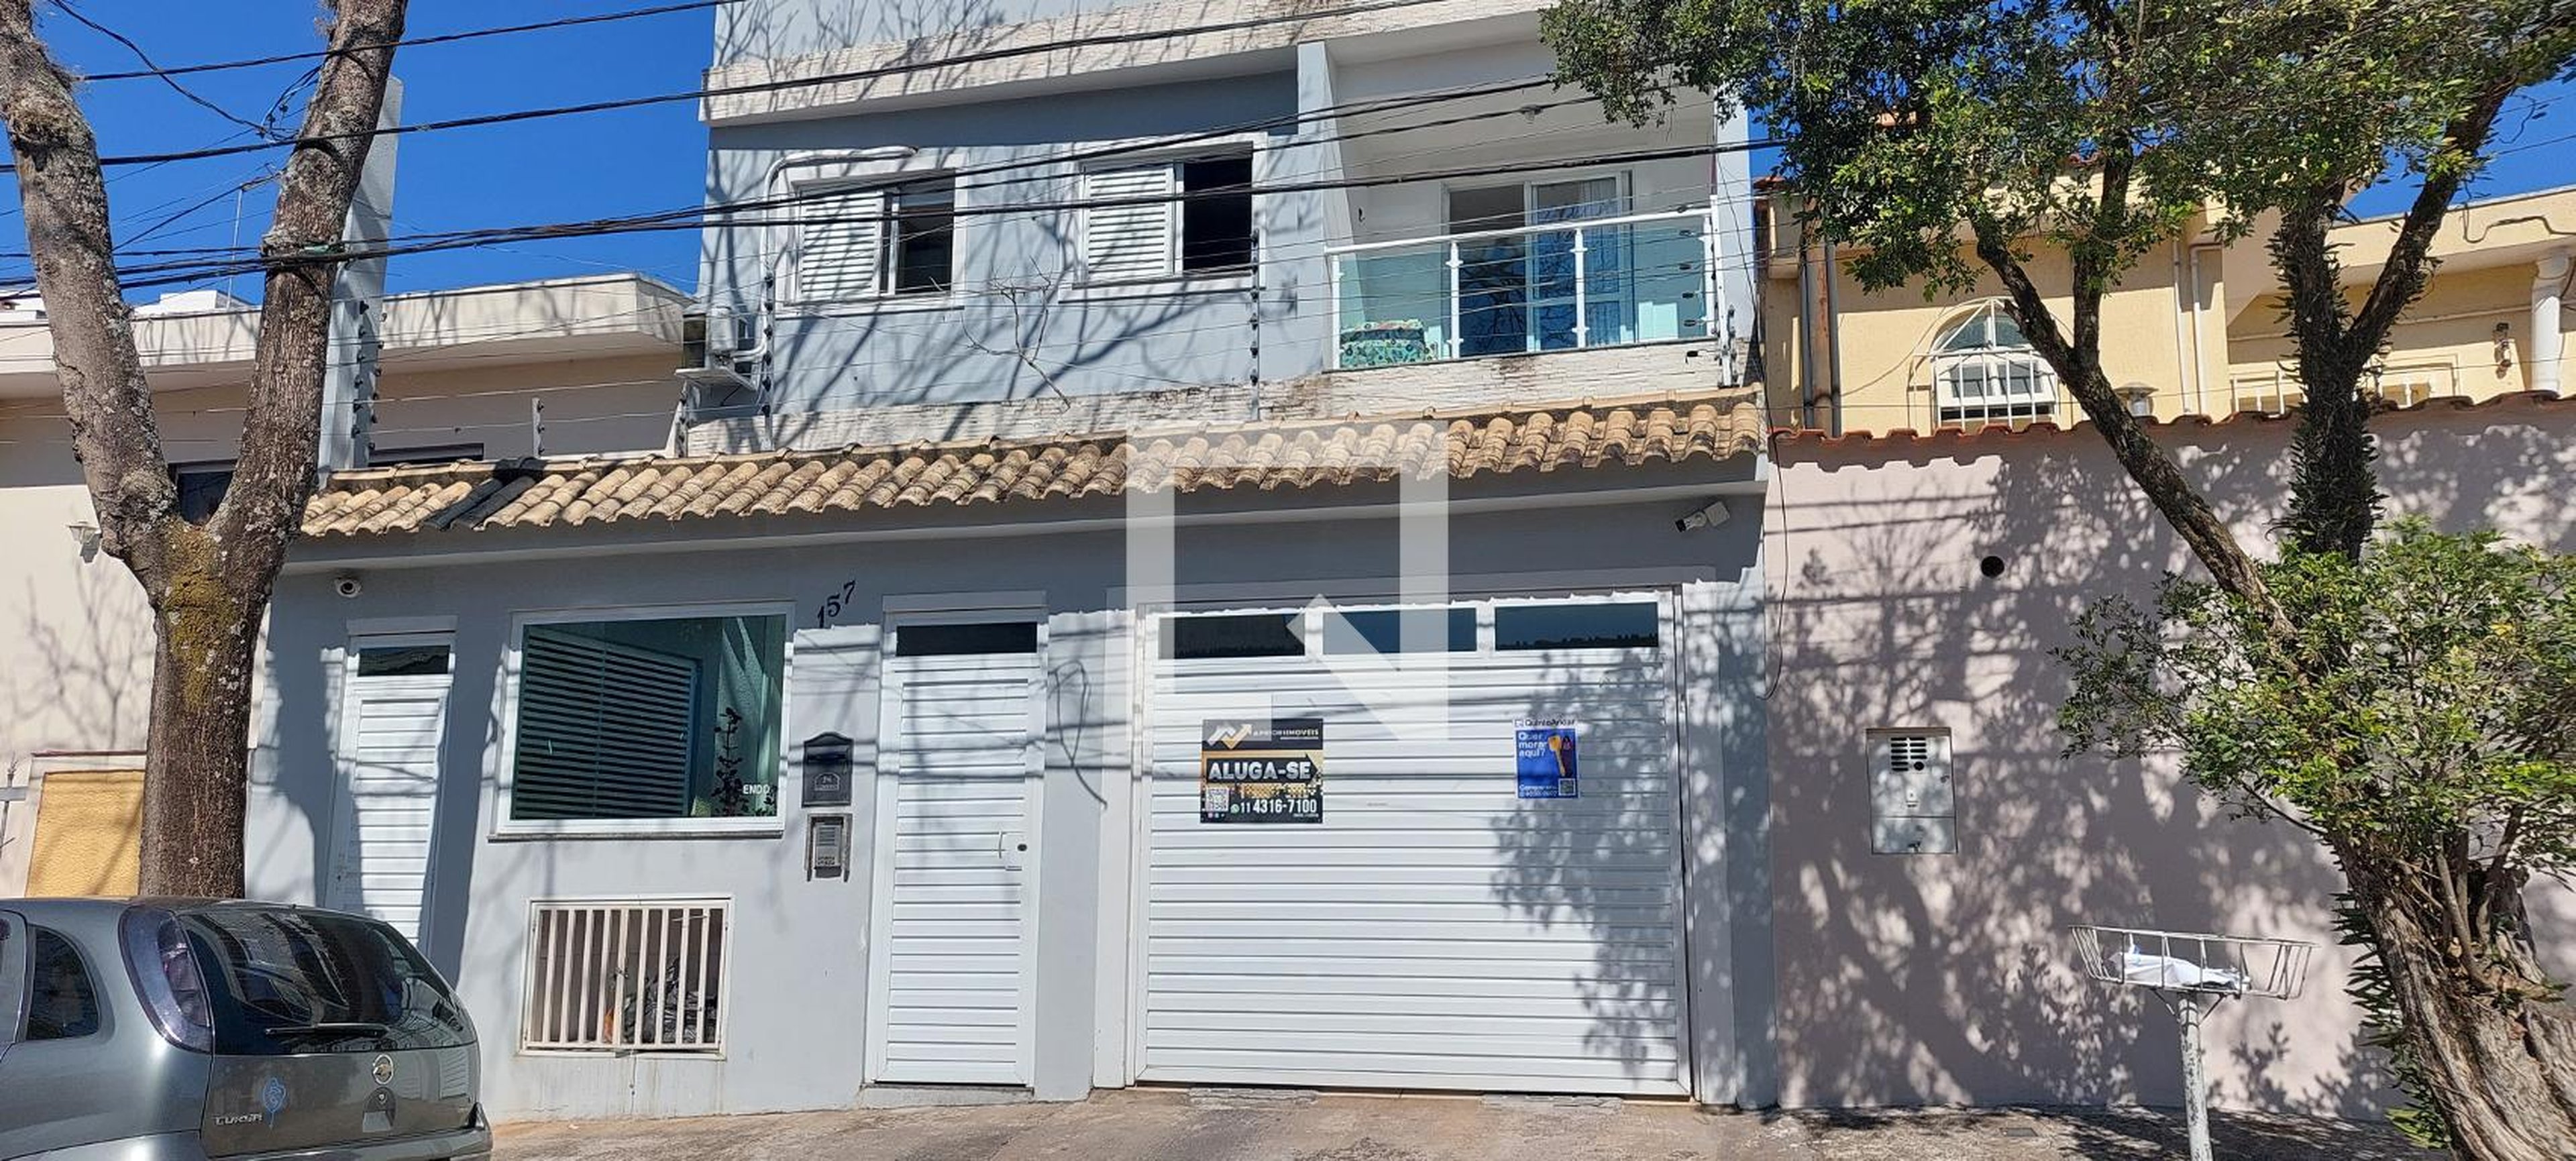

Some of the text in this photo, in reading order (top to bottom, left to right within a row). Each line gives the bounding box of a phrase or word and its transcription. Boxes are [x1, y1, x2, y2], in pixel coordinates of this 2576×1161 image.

[818, 579, 855, 628] 157
[1208, 761, 1311, 780] ALUGA-SE
[1252, 799, 1317, 814] 4316-7100
